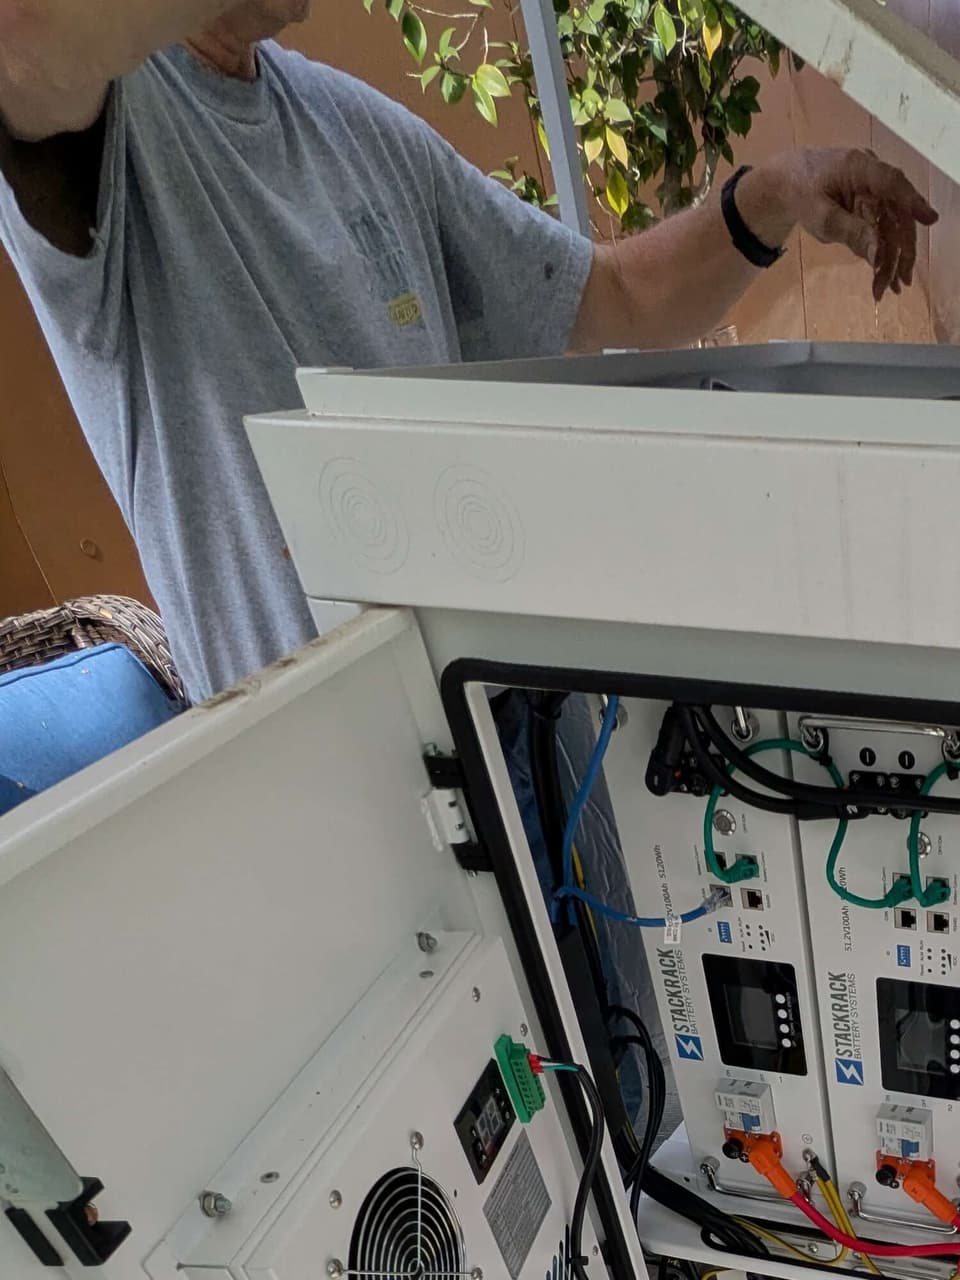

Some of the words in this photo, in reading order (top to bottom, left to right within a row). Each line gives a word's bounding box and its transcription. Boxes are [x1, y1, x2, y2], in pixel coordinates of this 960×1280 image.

[840, 905, 852, 952] 51.2V100Ah
[656, 947, 690, 1034] STACKRACK
[673, 948, 691, 994] SYSTEMS
[685, 995, 699, 1035] BATTERY
[828, 971, 853, 1058] STACKRACK
[847, 973, 859, 1018] SYSTEMS
[850, 1019, 862, 1060] BATTERY
